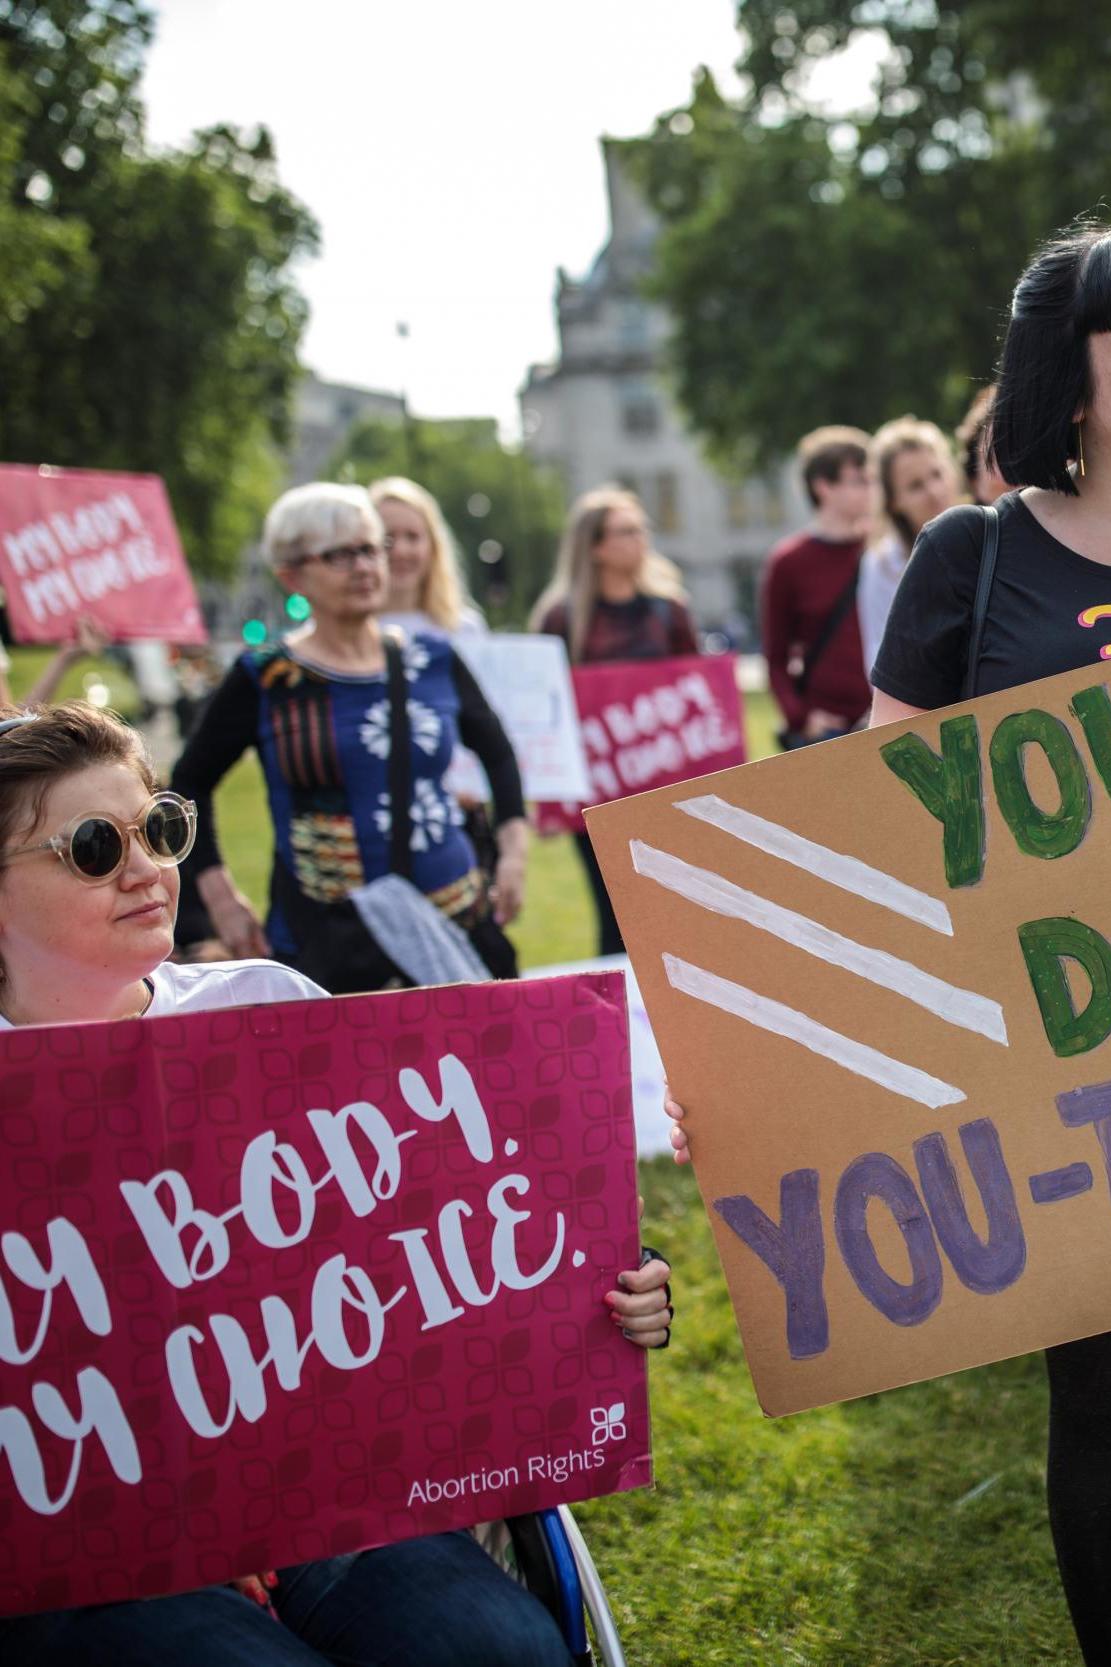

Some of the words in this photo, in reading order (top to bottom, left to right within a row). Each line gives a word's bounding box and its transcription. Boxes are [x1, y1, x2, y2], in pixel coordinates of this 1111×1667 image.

[120, 1054, 519, 1288] BODY.
[165, 1174, 586, 1438] CHOICE.
[407, 1466, 519, 1507] Abortion
[527, 1448, 606, 1483] Rights
